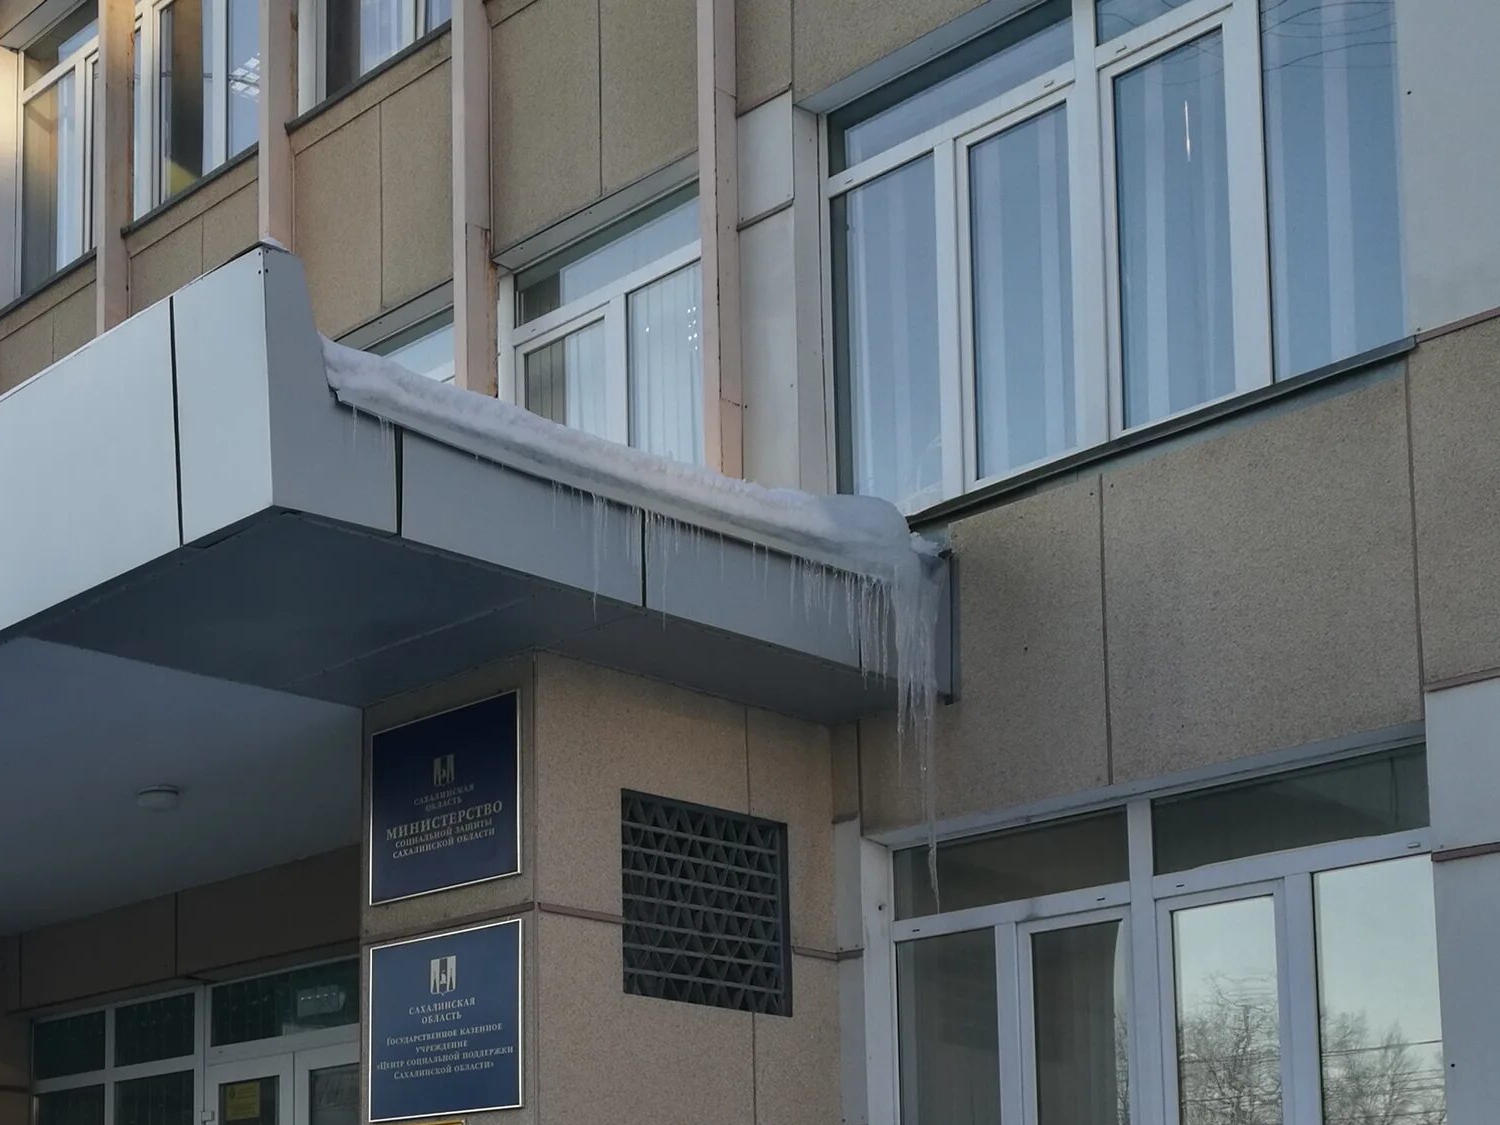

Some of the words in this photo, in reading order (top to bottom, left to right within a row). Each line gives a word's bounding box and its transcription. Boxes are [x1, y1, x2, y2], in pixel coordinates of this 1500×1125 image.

[386, 800, 503, 840] МИНИСТЕРСТВО
[392, 837, 454, 859] САХАЛИНСКОЙ
[457, 828, 495, 844] ОБЛАСТИ
[395, 827, 453, 849] СОЦИАЛЬНОЙ
[456, 818, 493, 833] ЗАЩИТЫ
[408, 997, 476, 1016] САХАЛИНСКАЯ
[421, 1011, 462, 1025] ОБЛАСТЬ
[415, 1040, 468, 1054] УЧРЕЖДЕНИЕ
